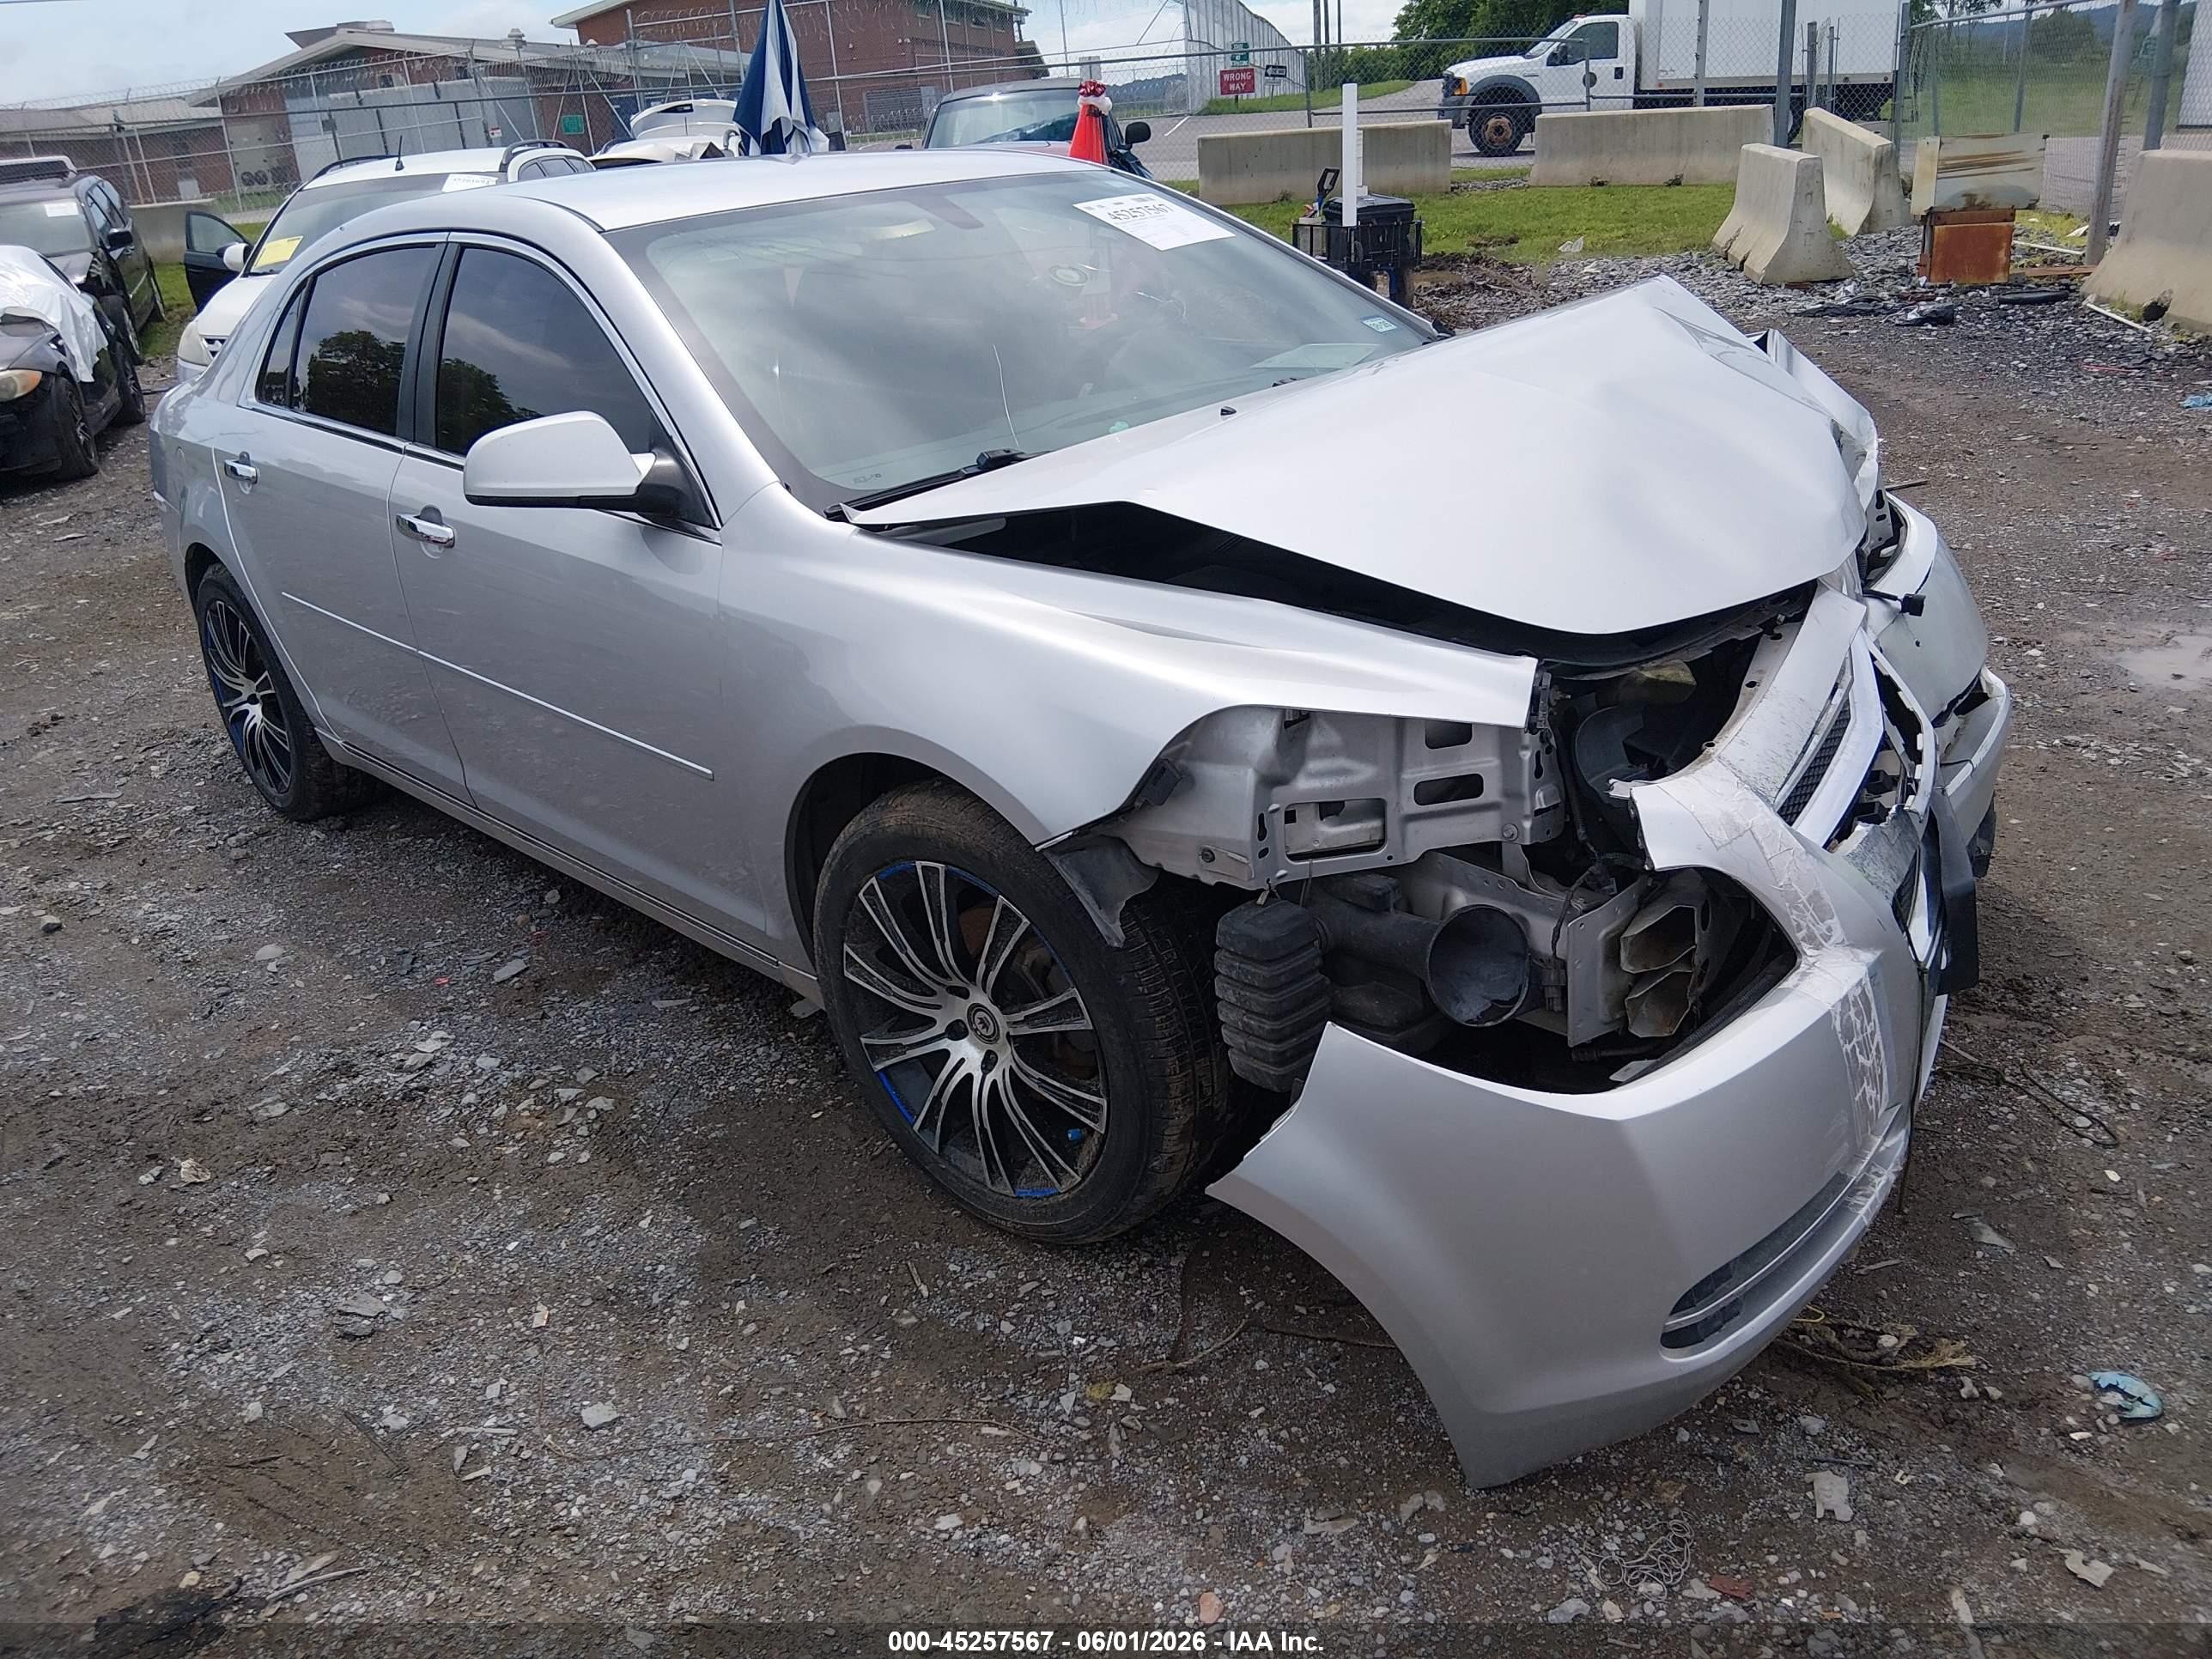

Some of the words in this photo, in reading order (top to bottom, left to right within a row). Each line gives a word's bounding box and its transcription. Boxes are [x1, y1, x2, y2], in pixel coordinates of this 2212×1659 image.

[1223, 71, 1252, 82] WRONG
[1229, 82, 1247, 91] WAY
[1107, 203, 1174, 221] 45257567
